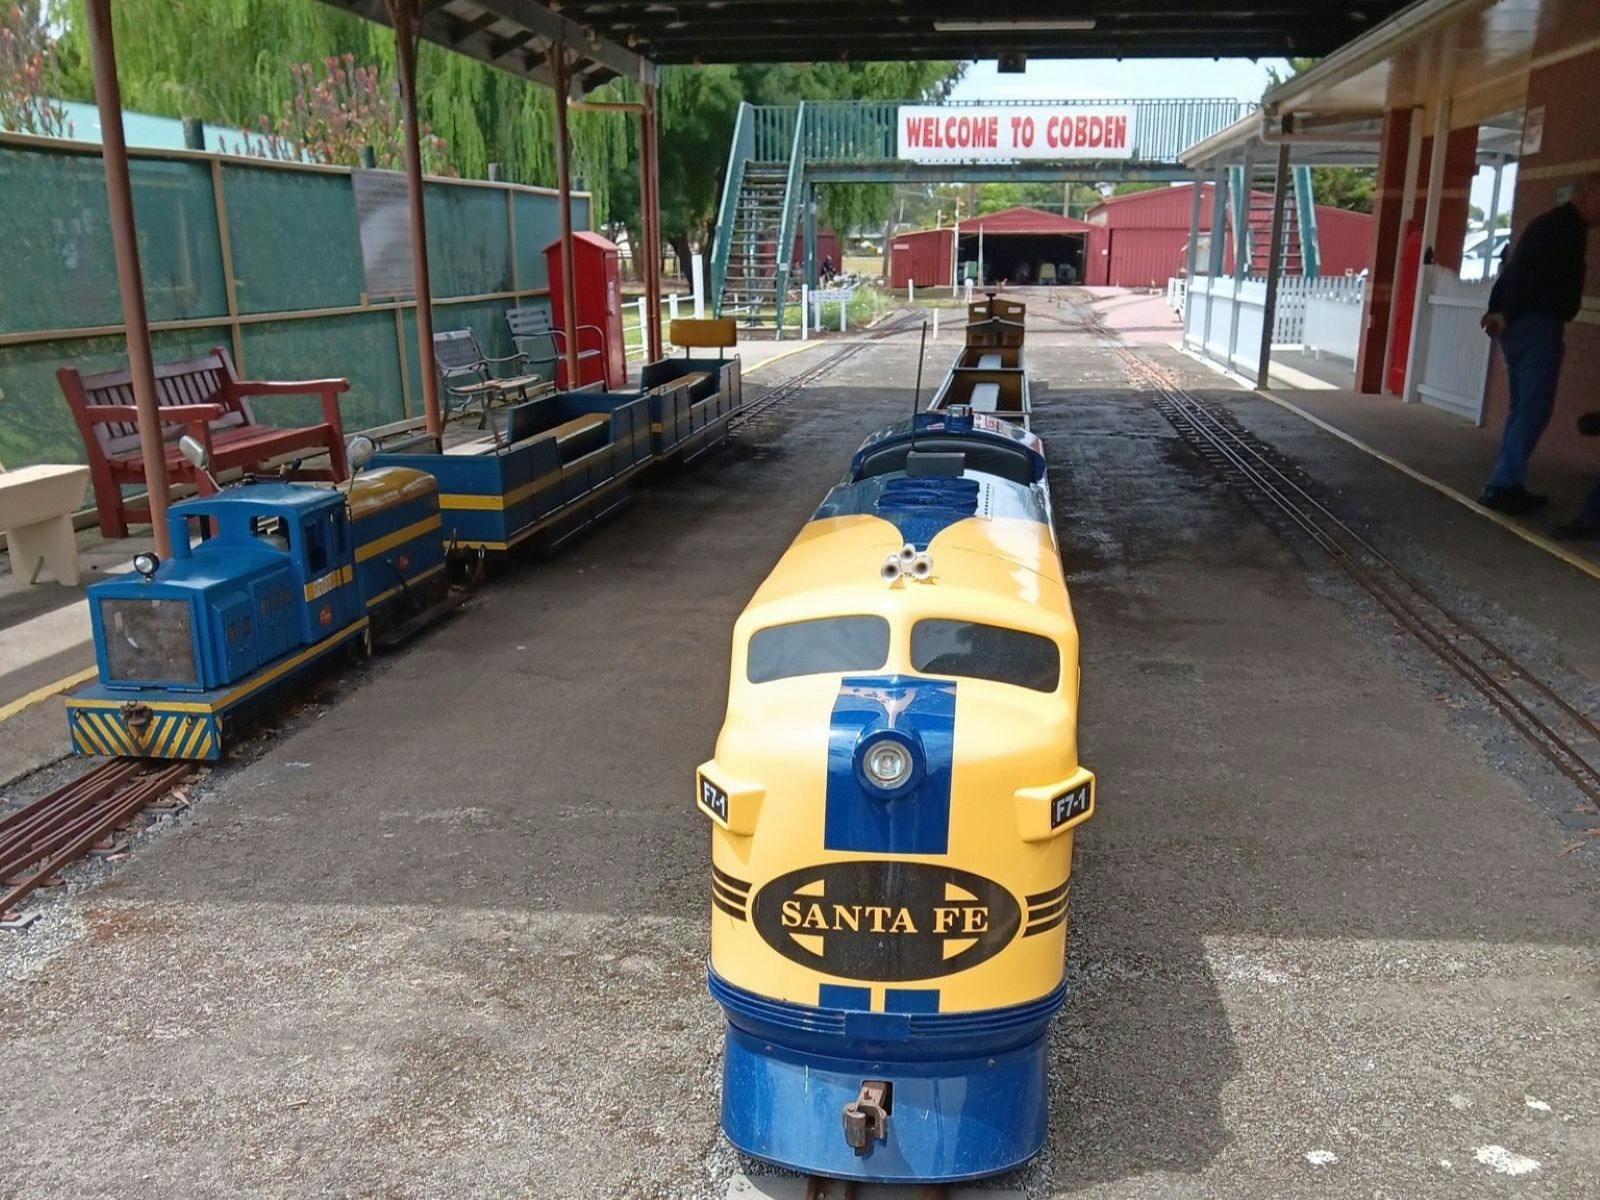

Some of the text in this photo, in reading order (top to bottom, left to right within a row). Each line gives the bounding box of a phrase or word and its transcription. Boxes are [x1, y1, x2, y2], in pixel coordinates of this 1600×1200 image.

[906, 115, 1127, 149] WELCOME TO COBDEN
[703, 781, 725, 818] F7-1
[1056, 787, 1086, 823] F7-1
[781, 900, 989, 934] SANTA FE
